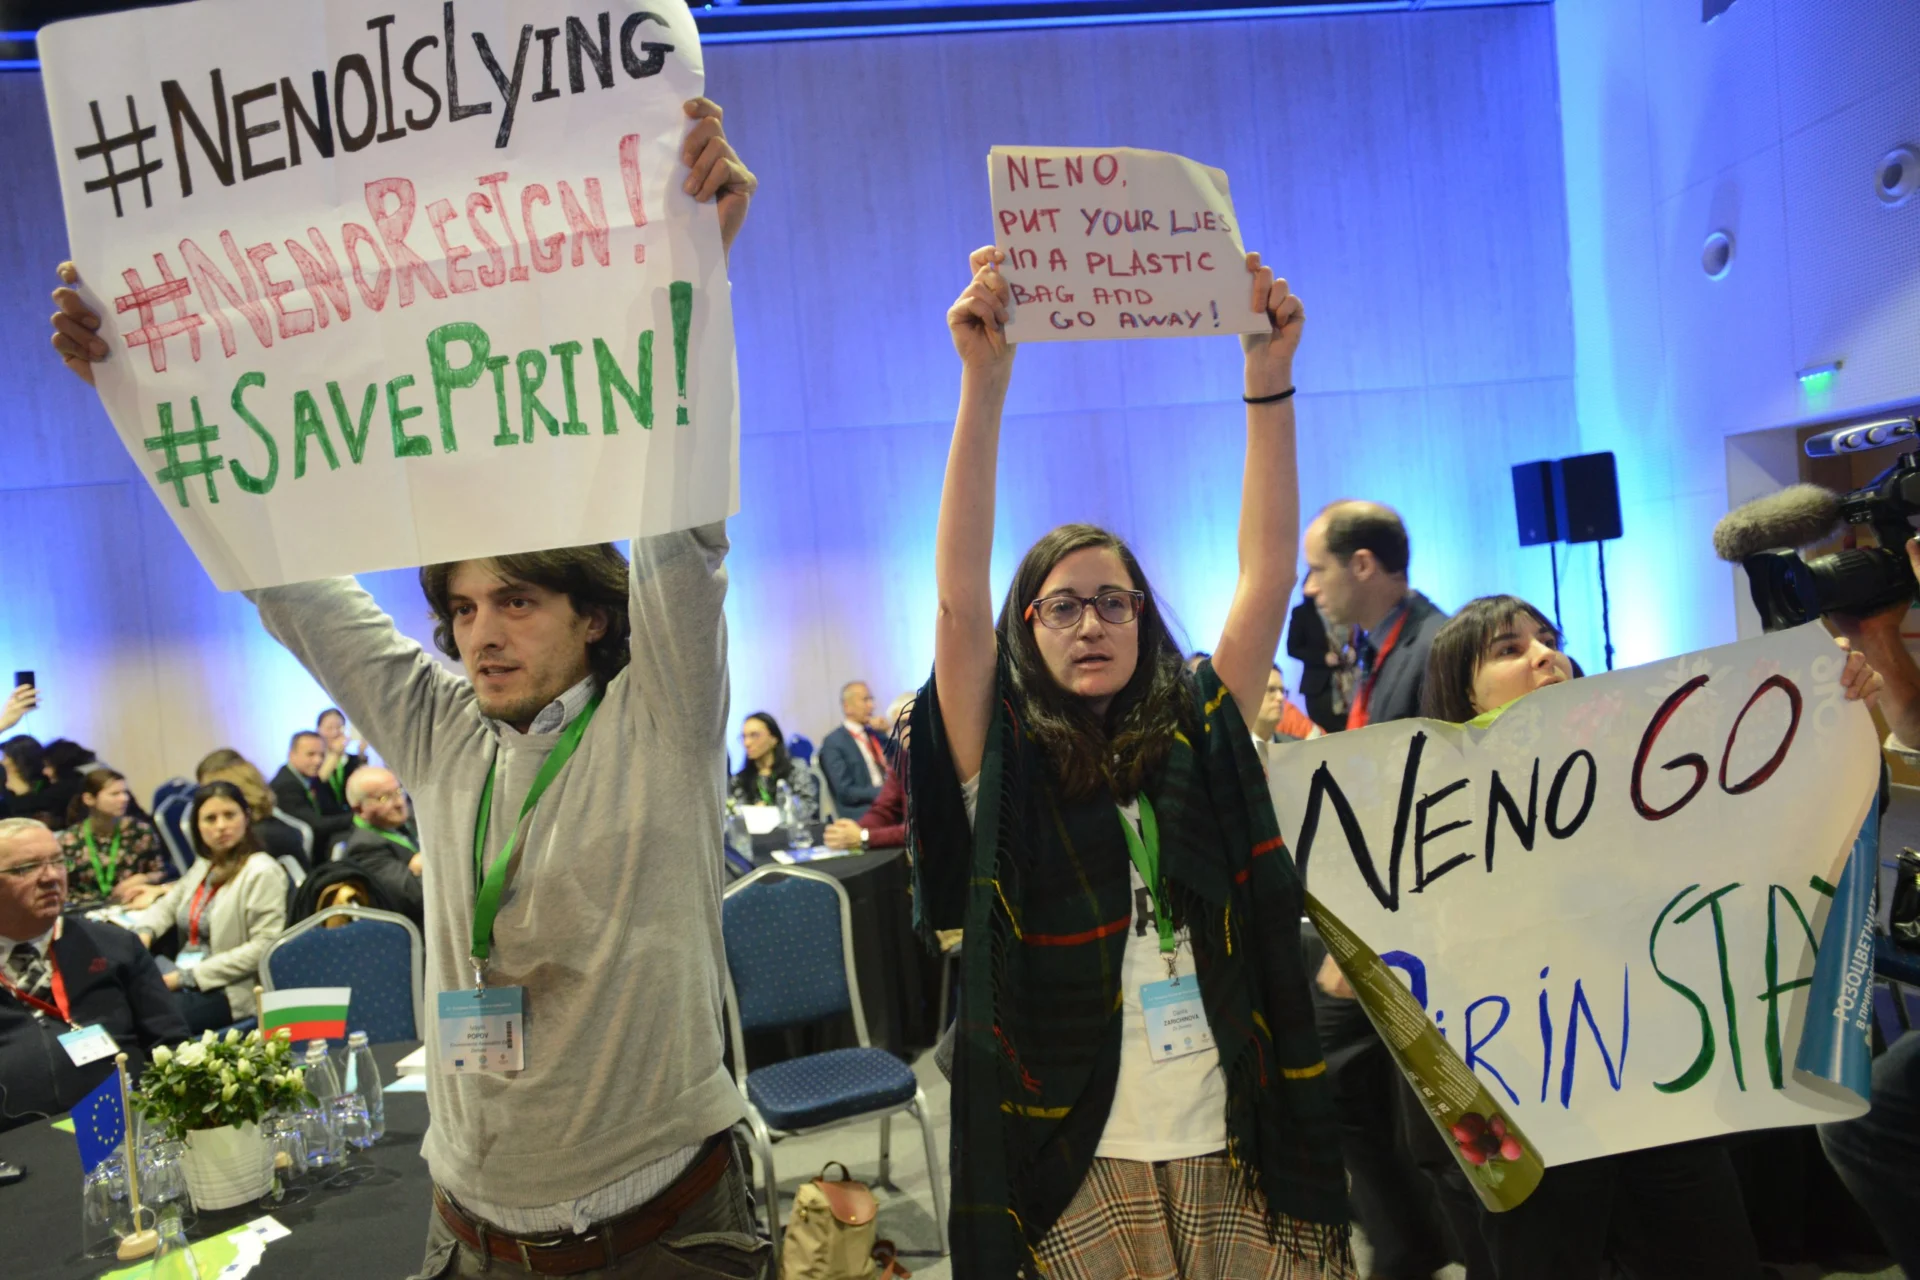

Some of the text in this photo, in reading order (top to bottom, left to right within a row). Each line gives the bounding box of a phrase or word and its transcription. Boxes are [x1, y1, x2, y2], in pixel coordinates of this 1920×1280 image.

[1007, 154, 1127, 191] NENO,
[999, 208, 1232, 236] PUT YOUR LIES
[1049, 247, 1067, 272] A
[1086, 249, 1217, 277] PLASTIC
[1009, 282, 1075, 306] BAG
[1050, 300, 1221, 330] GO AWAY!
[1295, 731, 1597, 913] NENO
[1630, 674, 1804, 822] GO
[1649, 875, 1837, 1095] STA
[467, 1032, 489, 1040] POPOV
